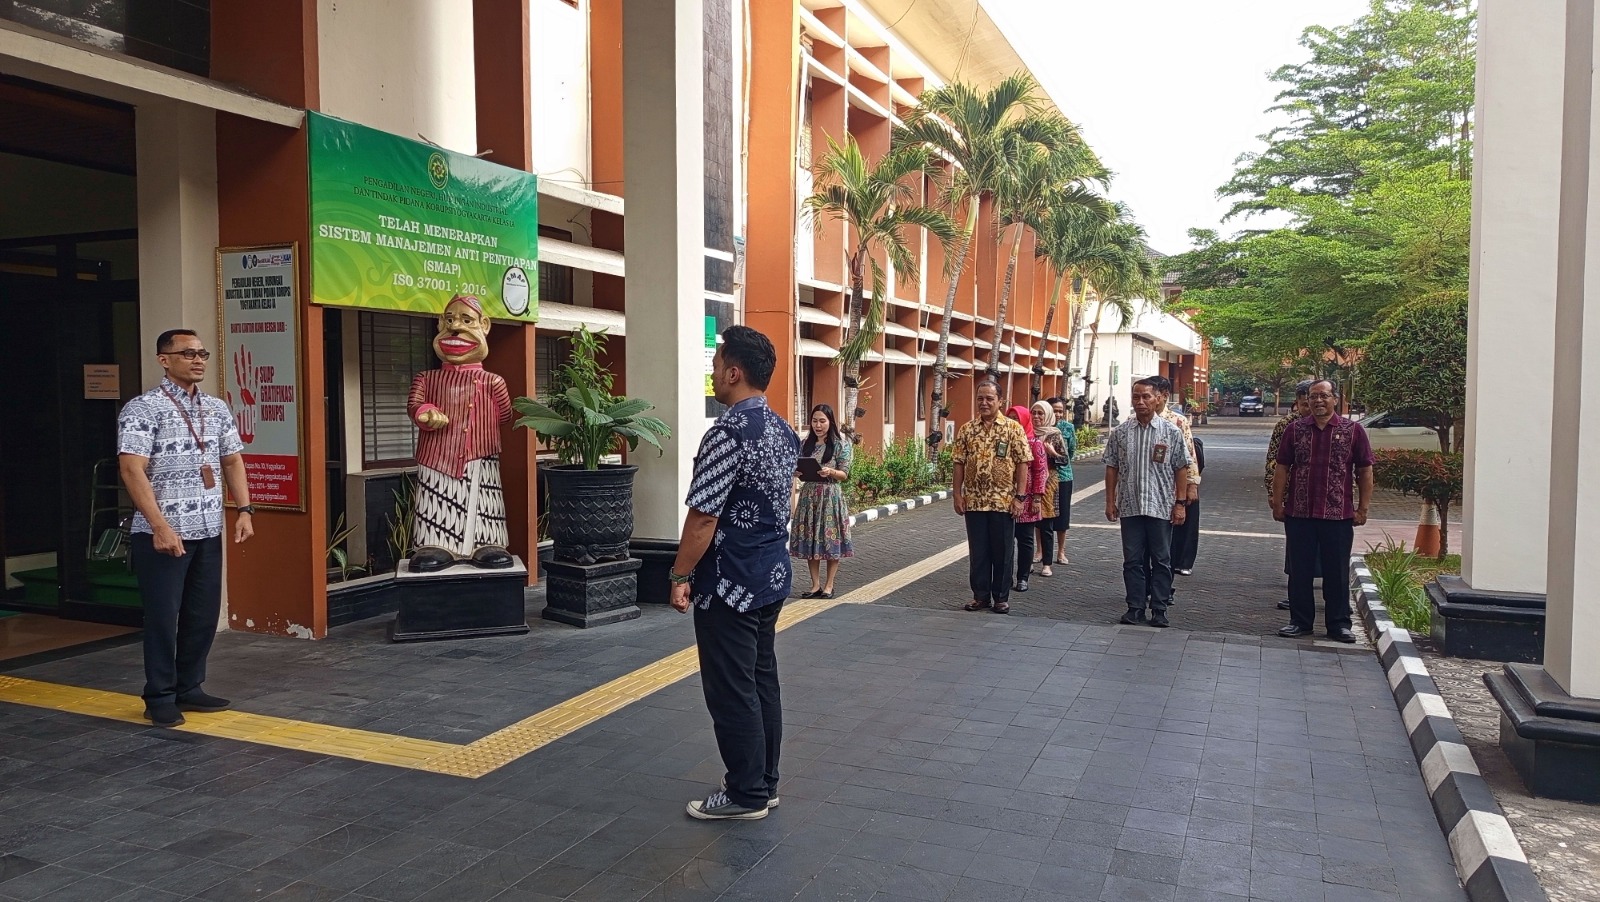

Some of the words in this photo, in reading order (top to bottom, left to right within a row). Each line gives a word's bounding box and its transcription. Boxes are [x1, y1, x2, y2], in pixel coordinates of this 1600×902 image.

[363, 176, 411, 194] PENGADILAN
[354, 187, 369, 197] DAN
[370, 189, 398, 203] TINDAK
[399, 196, 425, 209] PIDANA
[378, 214, 420, 234] TELAH
[424, 221, 498, 248] MENERAPKAN
[319, 224, 371, 245] SISTEM
[376, 233, 451, 257] MANAJEMEN
[454, 247, 480, 262] ANTI
[482, 252, 537, 271] PENYUAPAN
[423, 260, 461, 278] (SMAP)
[506, 272, 526, 283] SMAP
[392, 273, 414, 287] ISO
[417, 275, 451, 292] 37001
[461, 282, 487, 296] 2016
[260, 366, 274, 383] SUAP
[261, 385, 294, 402] GRATIFIKASI
[261, 404, 285, 421] KORUPSI
